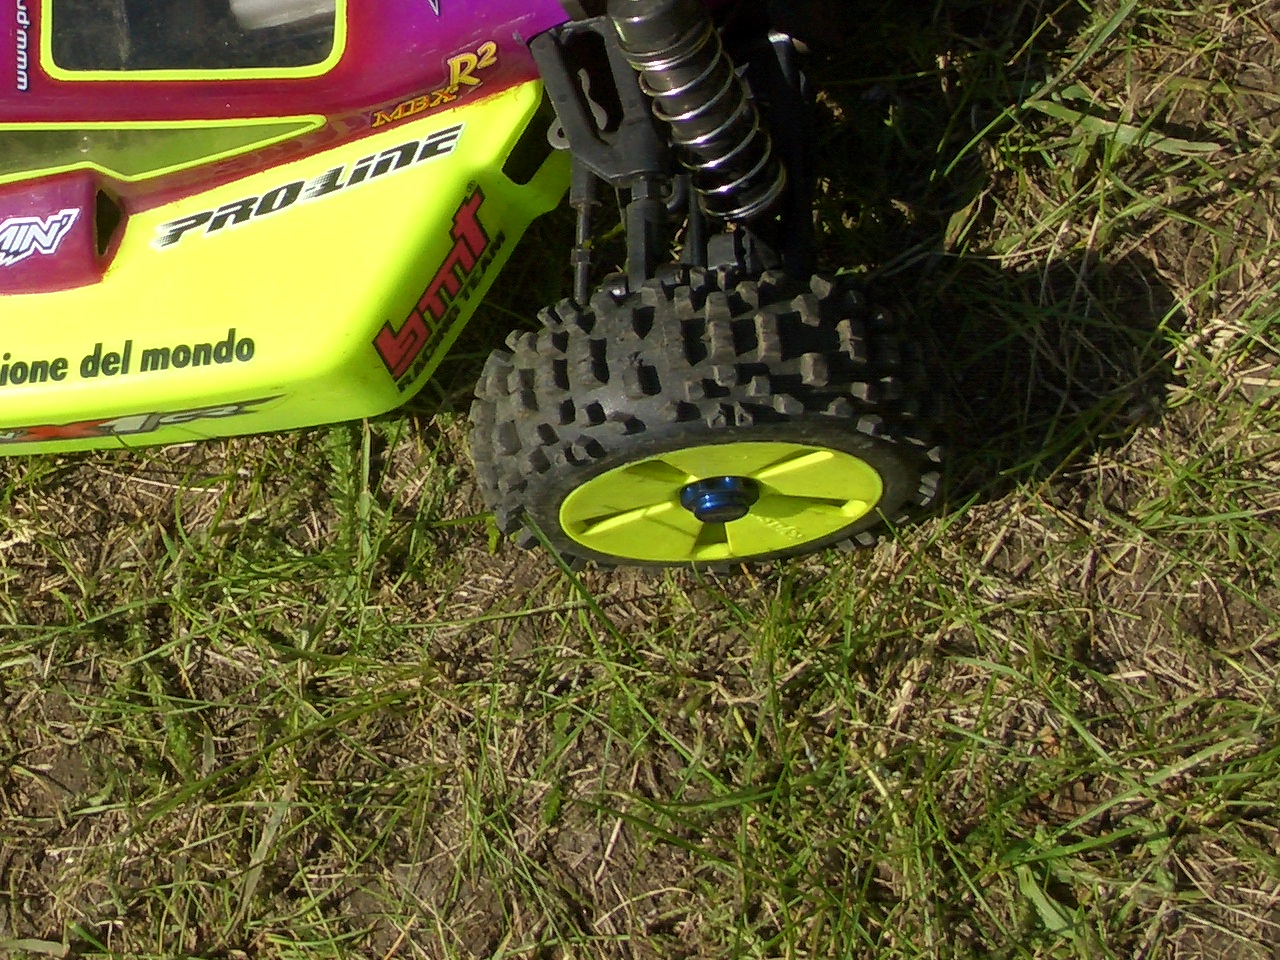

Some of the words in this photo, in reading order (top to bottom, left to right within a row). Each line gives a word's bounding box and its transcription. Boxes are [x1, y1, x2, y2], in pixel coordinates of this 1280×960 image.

[459, 229, 507, 299] TEAM
[79, 339, 133, 378] del
[140, 327, 256, 373] mondo
